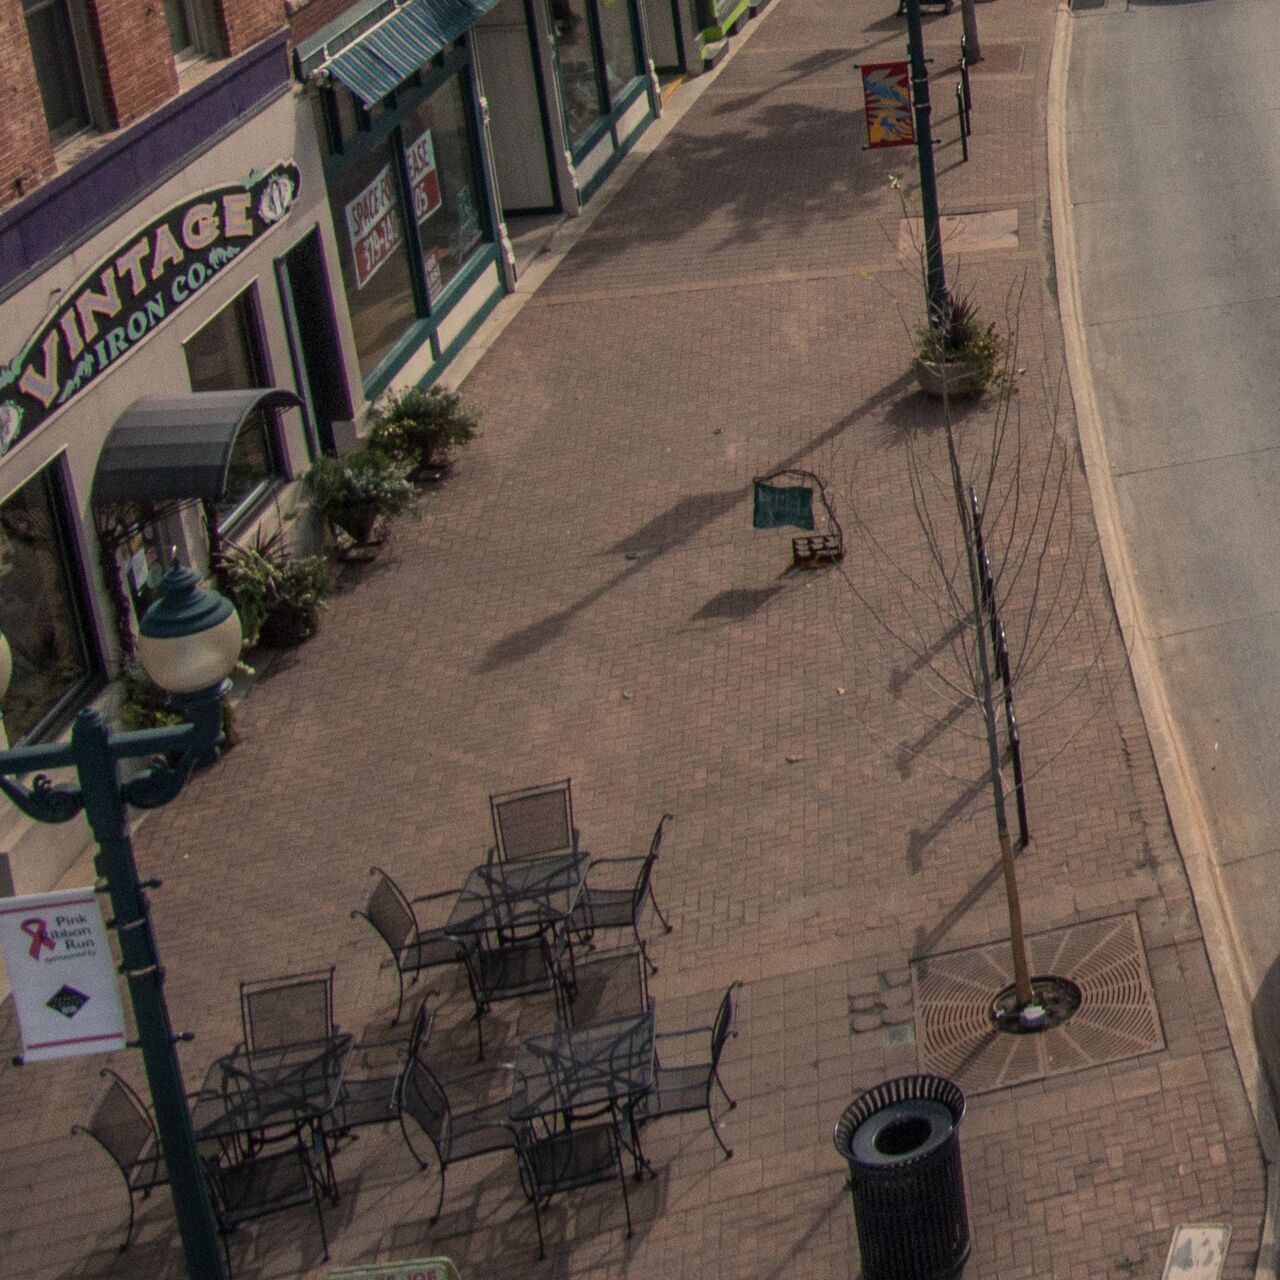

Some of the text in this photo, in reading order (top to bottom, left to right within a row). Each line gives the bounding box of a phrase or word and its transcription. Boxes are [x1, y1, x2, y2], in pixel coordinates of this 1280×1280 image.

[19, 193, 255, 410] VINTAGE
[88, 260, 214, 371] IRON CO.
[55, 914, 88, 927] Pink
[65, 939, 96, 951] Run
